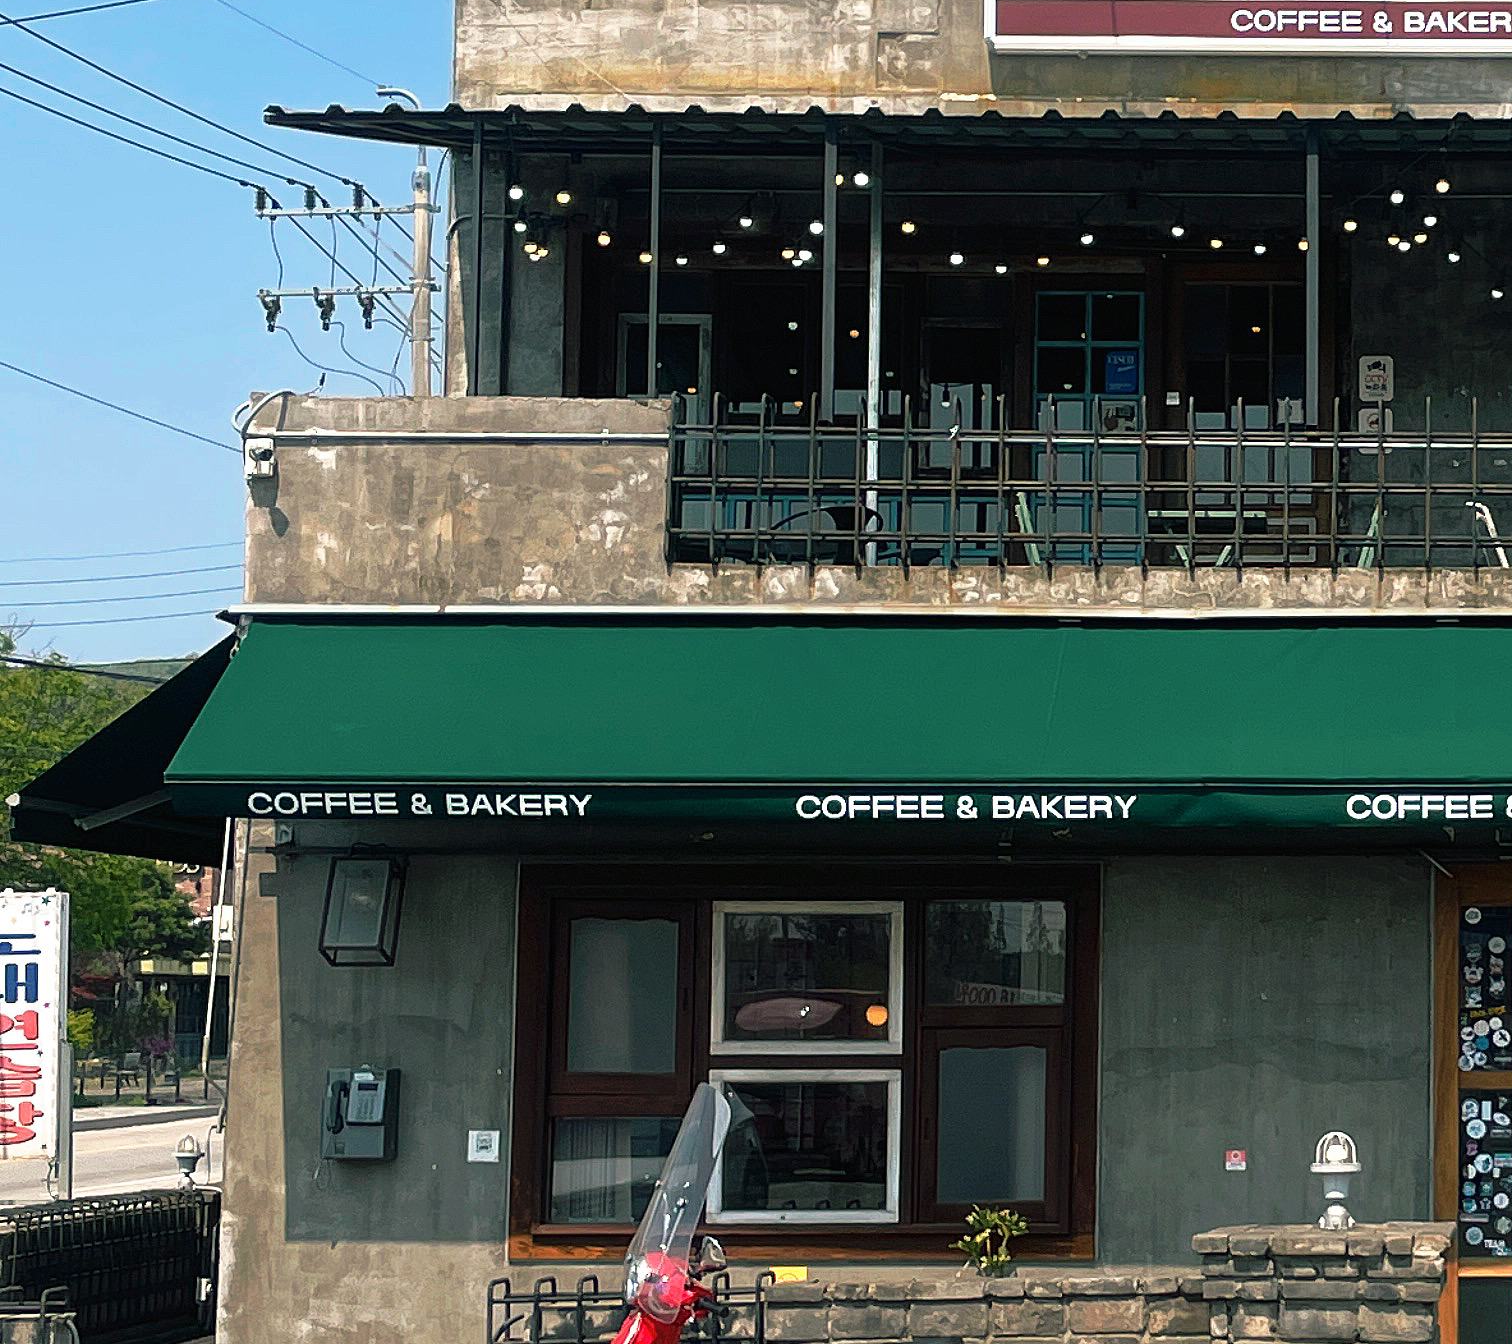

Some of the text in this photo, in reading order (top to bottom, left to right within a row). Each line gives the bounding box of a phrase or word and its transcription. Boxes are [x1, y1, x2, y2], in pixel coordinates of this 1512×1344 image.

[1230, 9, 1363, 33] COFFEE
[1372, 11, 1393, 33] &
[247, 791, 593, 816] COFFEE & BAKERY
[795, 794, 1137, 819] COFFEE & BAKERY
[1345, 793, 1494, 820] COFFEE
